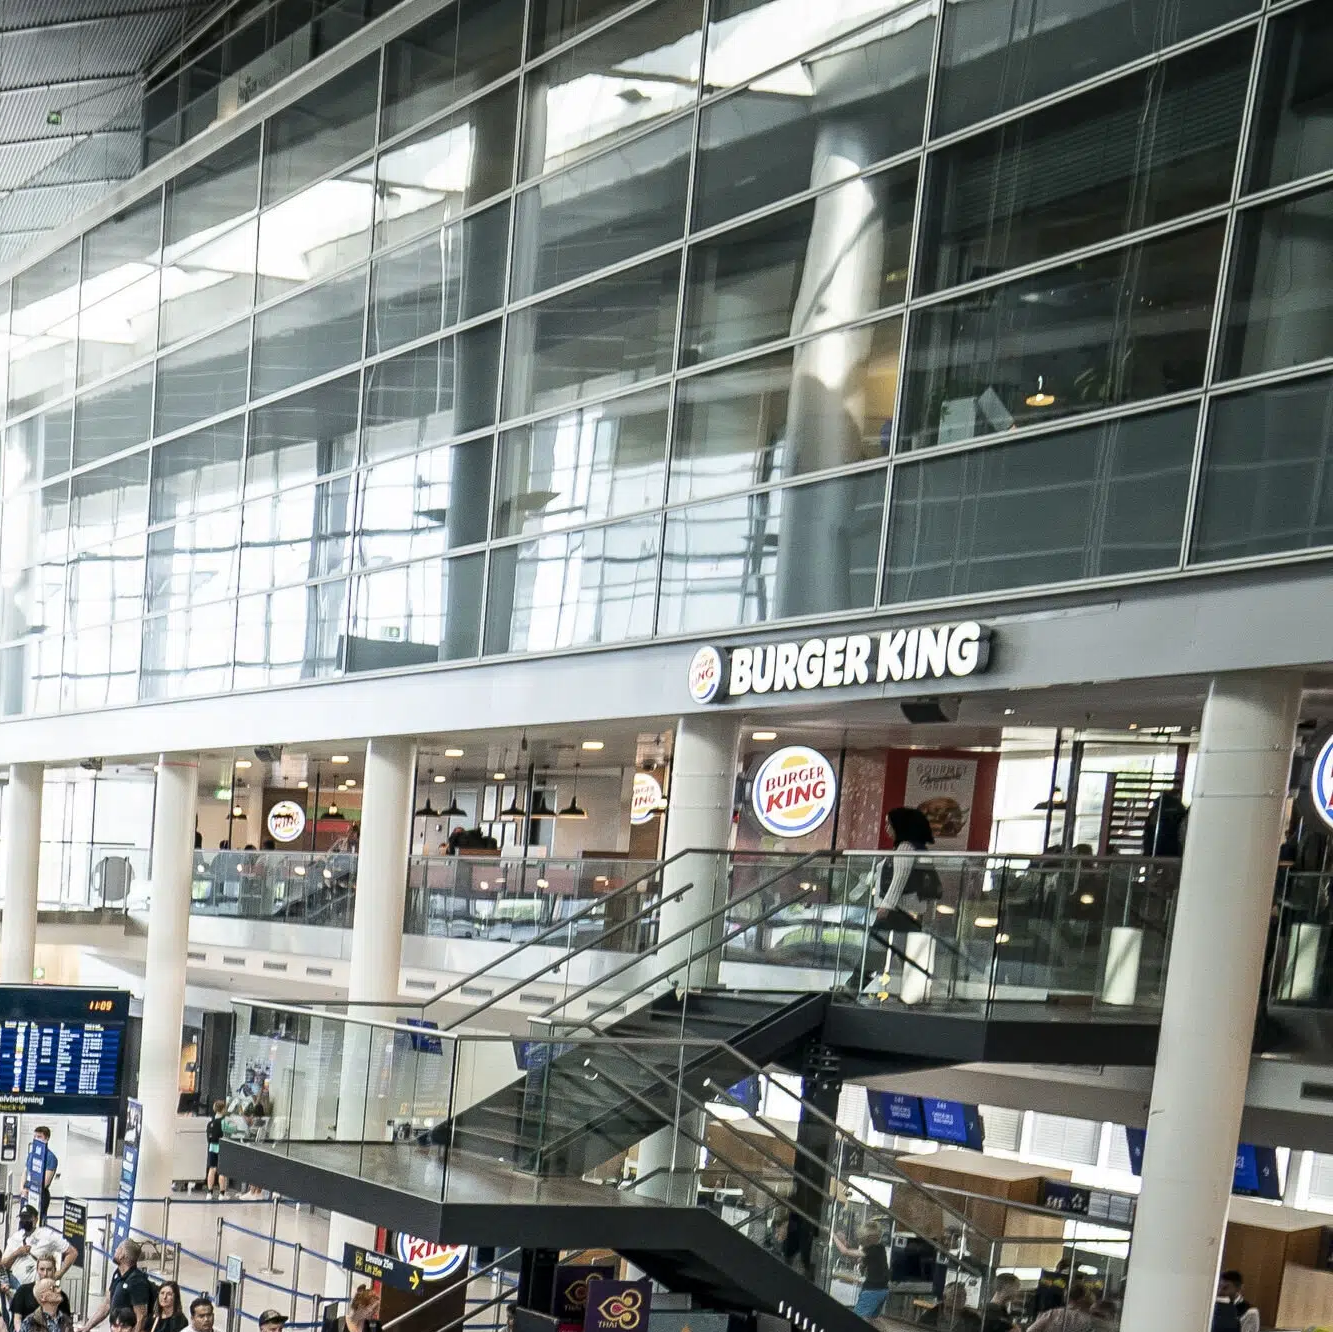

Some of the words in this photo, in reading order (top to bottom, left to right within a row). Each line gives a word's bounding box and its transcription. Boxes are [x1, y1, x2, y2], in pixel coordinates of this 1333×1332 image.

[730, 634, 871, 696] BURGER
[876, 621, 981, 683] KING
[766, 766, 825, 792] BURGER
[766, 781, 826, 813] KING
